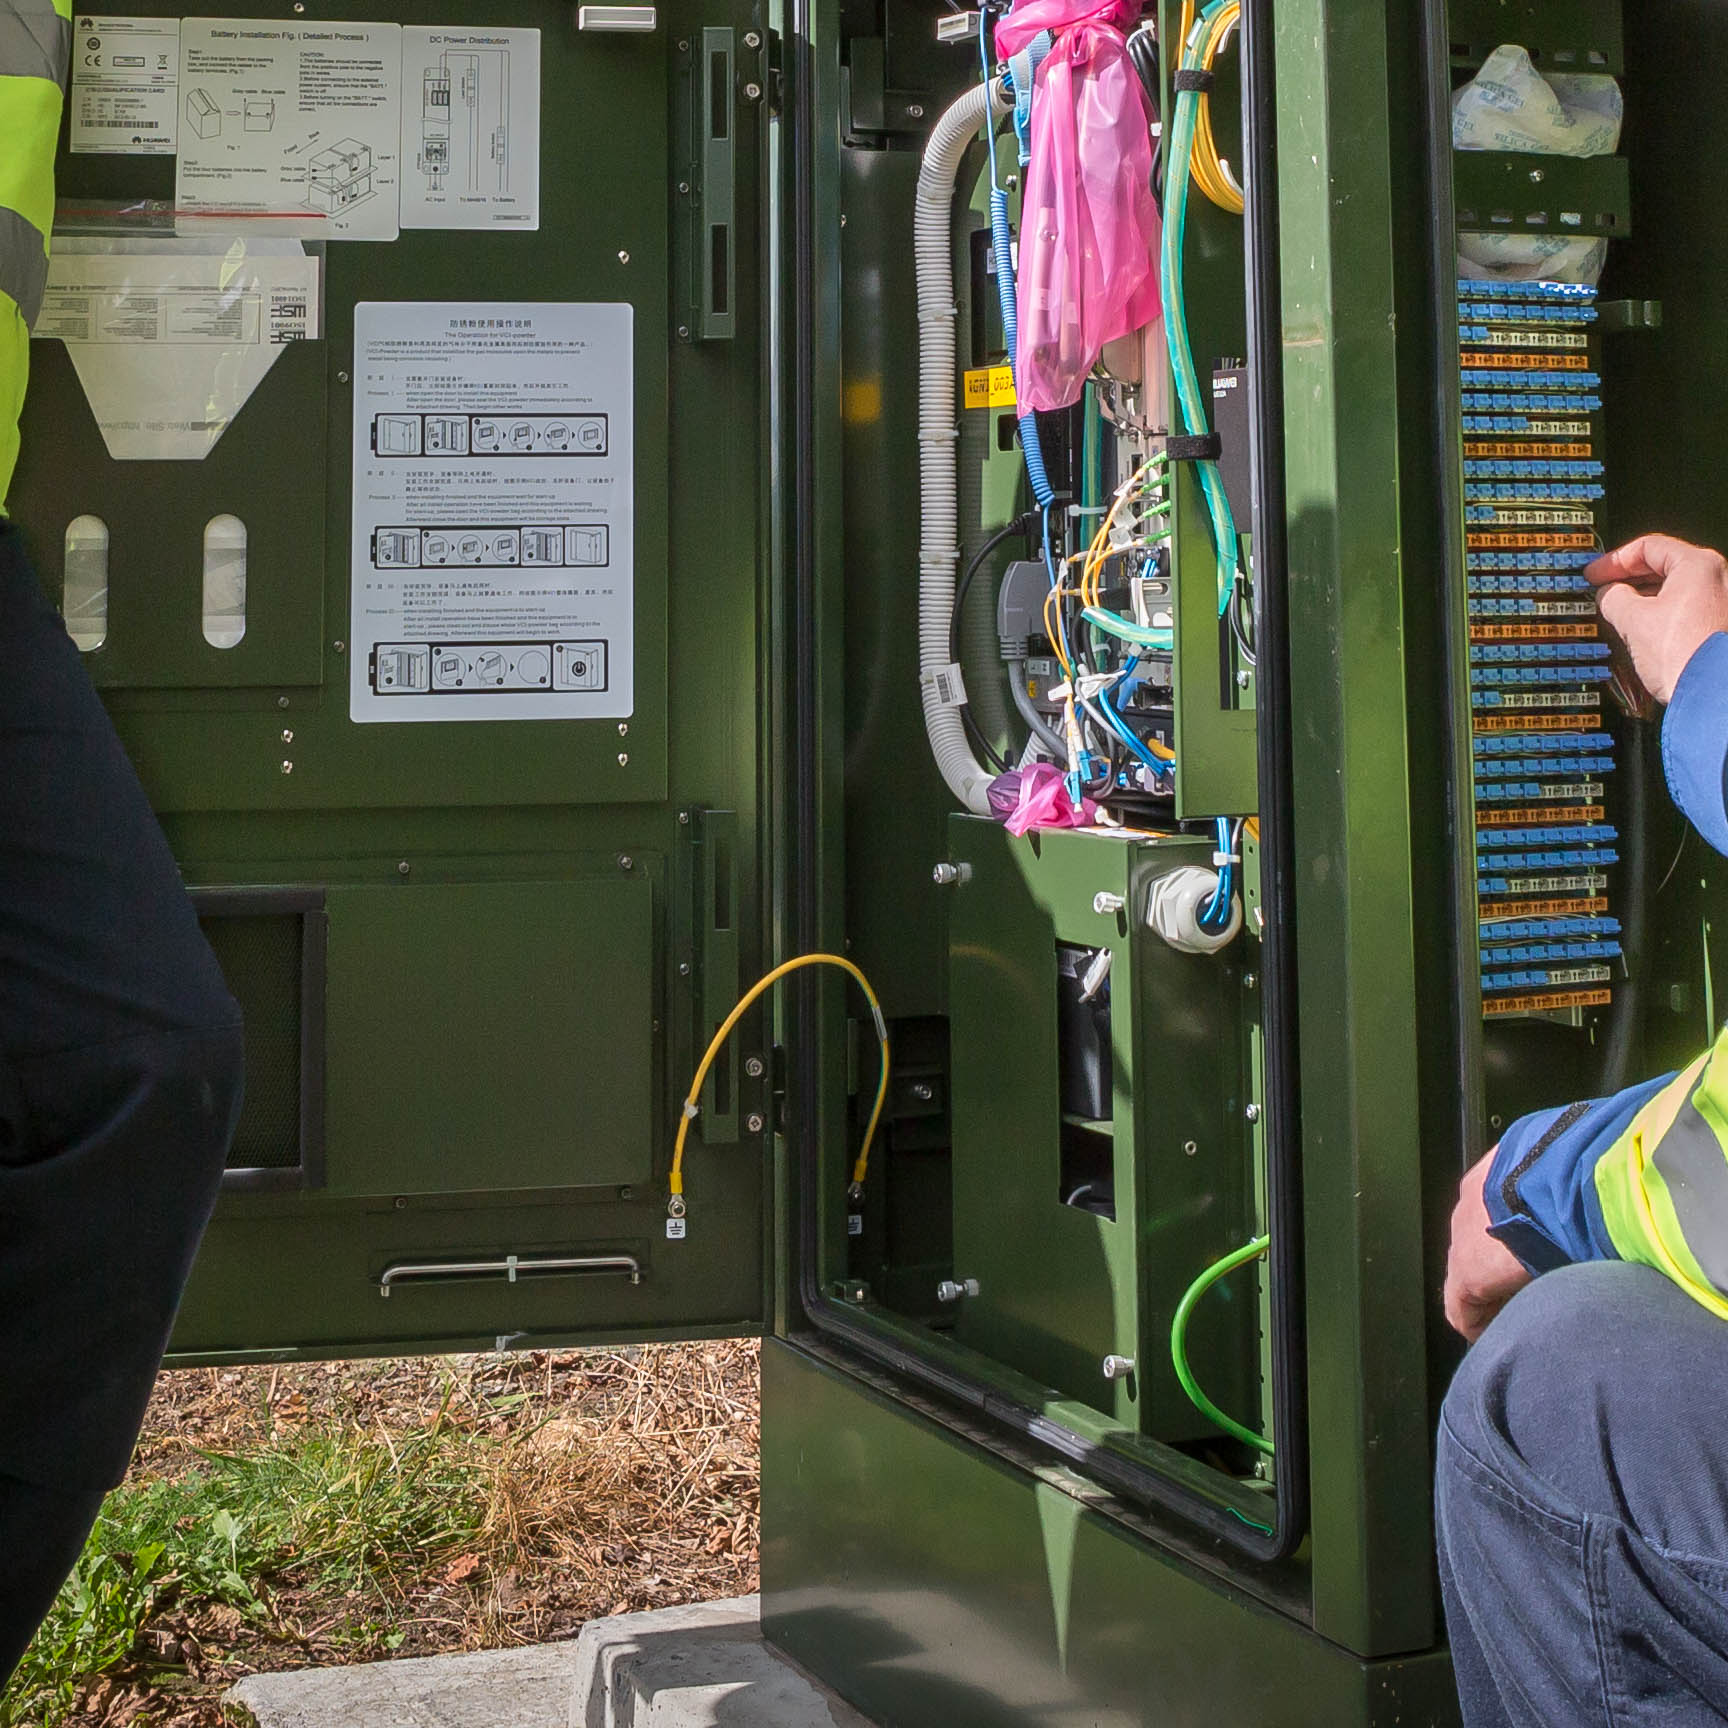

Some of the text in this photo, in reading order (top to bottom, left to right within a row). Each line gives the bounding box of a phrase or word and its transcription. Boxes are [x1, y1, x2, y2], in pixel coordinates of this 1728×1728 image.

[210, 30, 237, 40] Battery
[240, 32, 281, 40] Installation
[282, 32, 295, 41] Fig.
[443, 36, 467, 44] Power
[469, 37, 509, 45] Distribution
